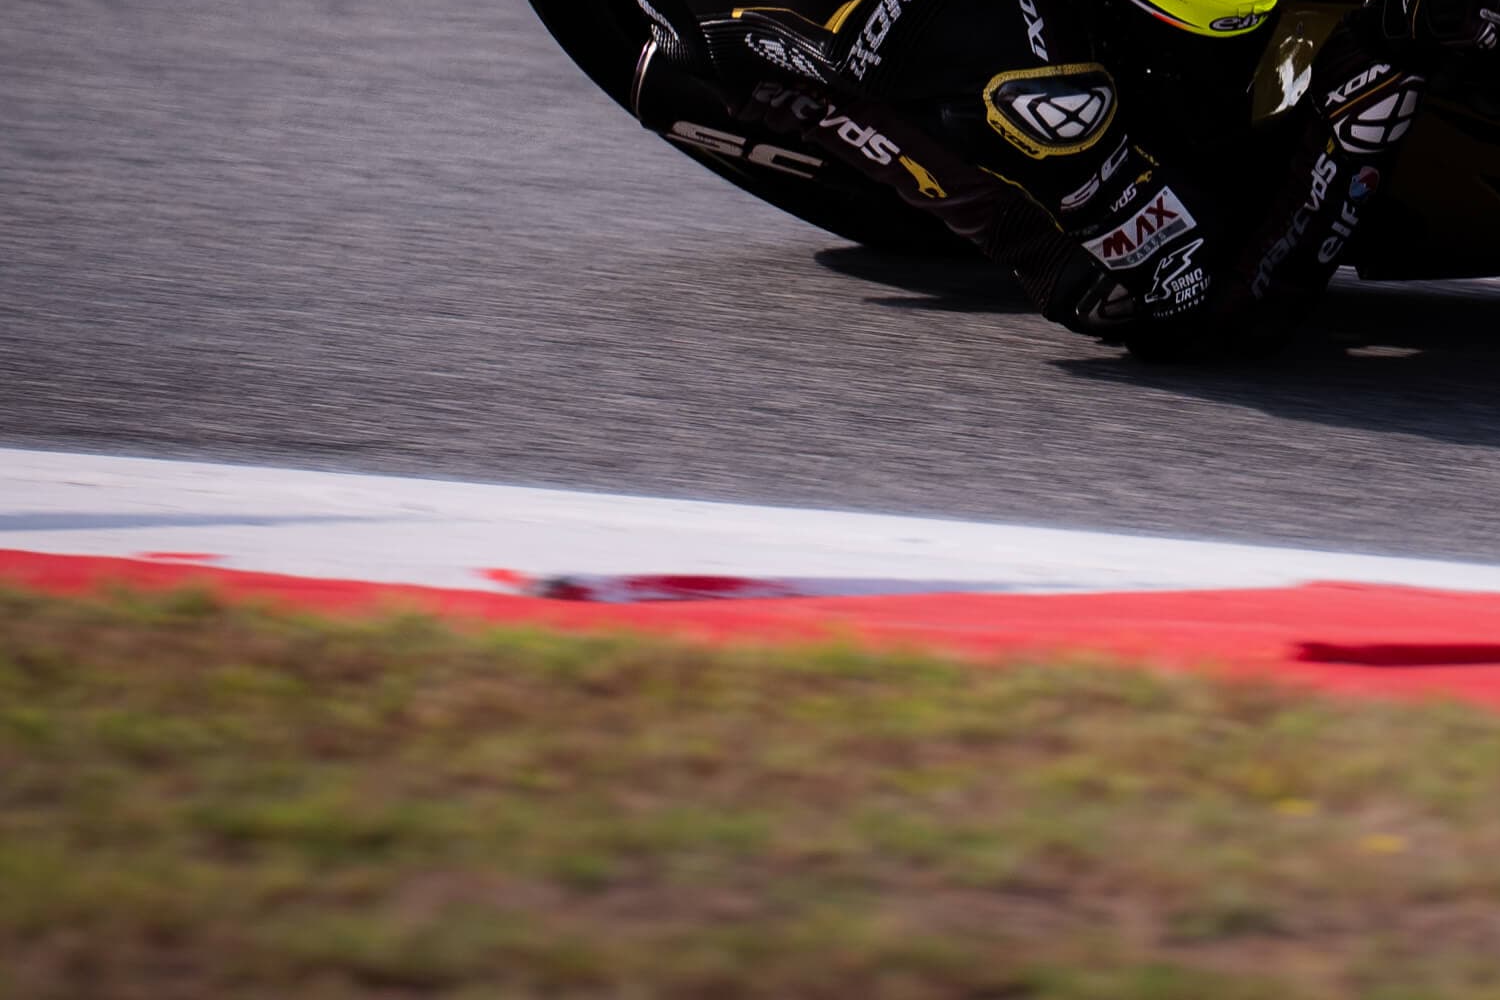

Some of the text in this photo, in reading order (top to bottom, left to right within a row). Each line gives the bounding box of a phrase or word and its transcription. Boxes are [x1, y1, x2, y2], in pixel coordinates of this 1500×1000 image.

[1324, 62, 1393, 108] XON
[1101, 195, 1180, 259] MAX
[1169, 267, 1206, 293] BRNO
